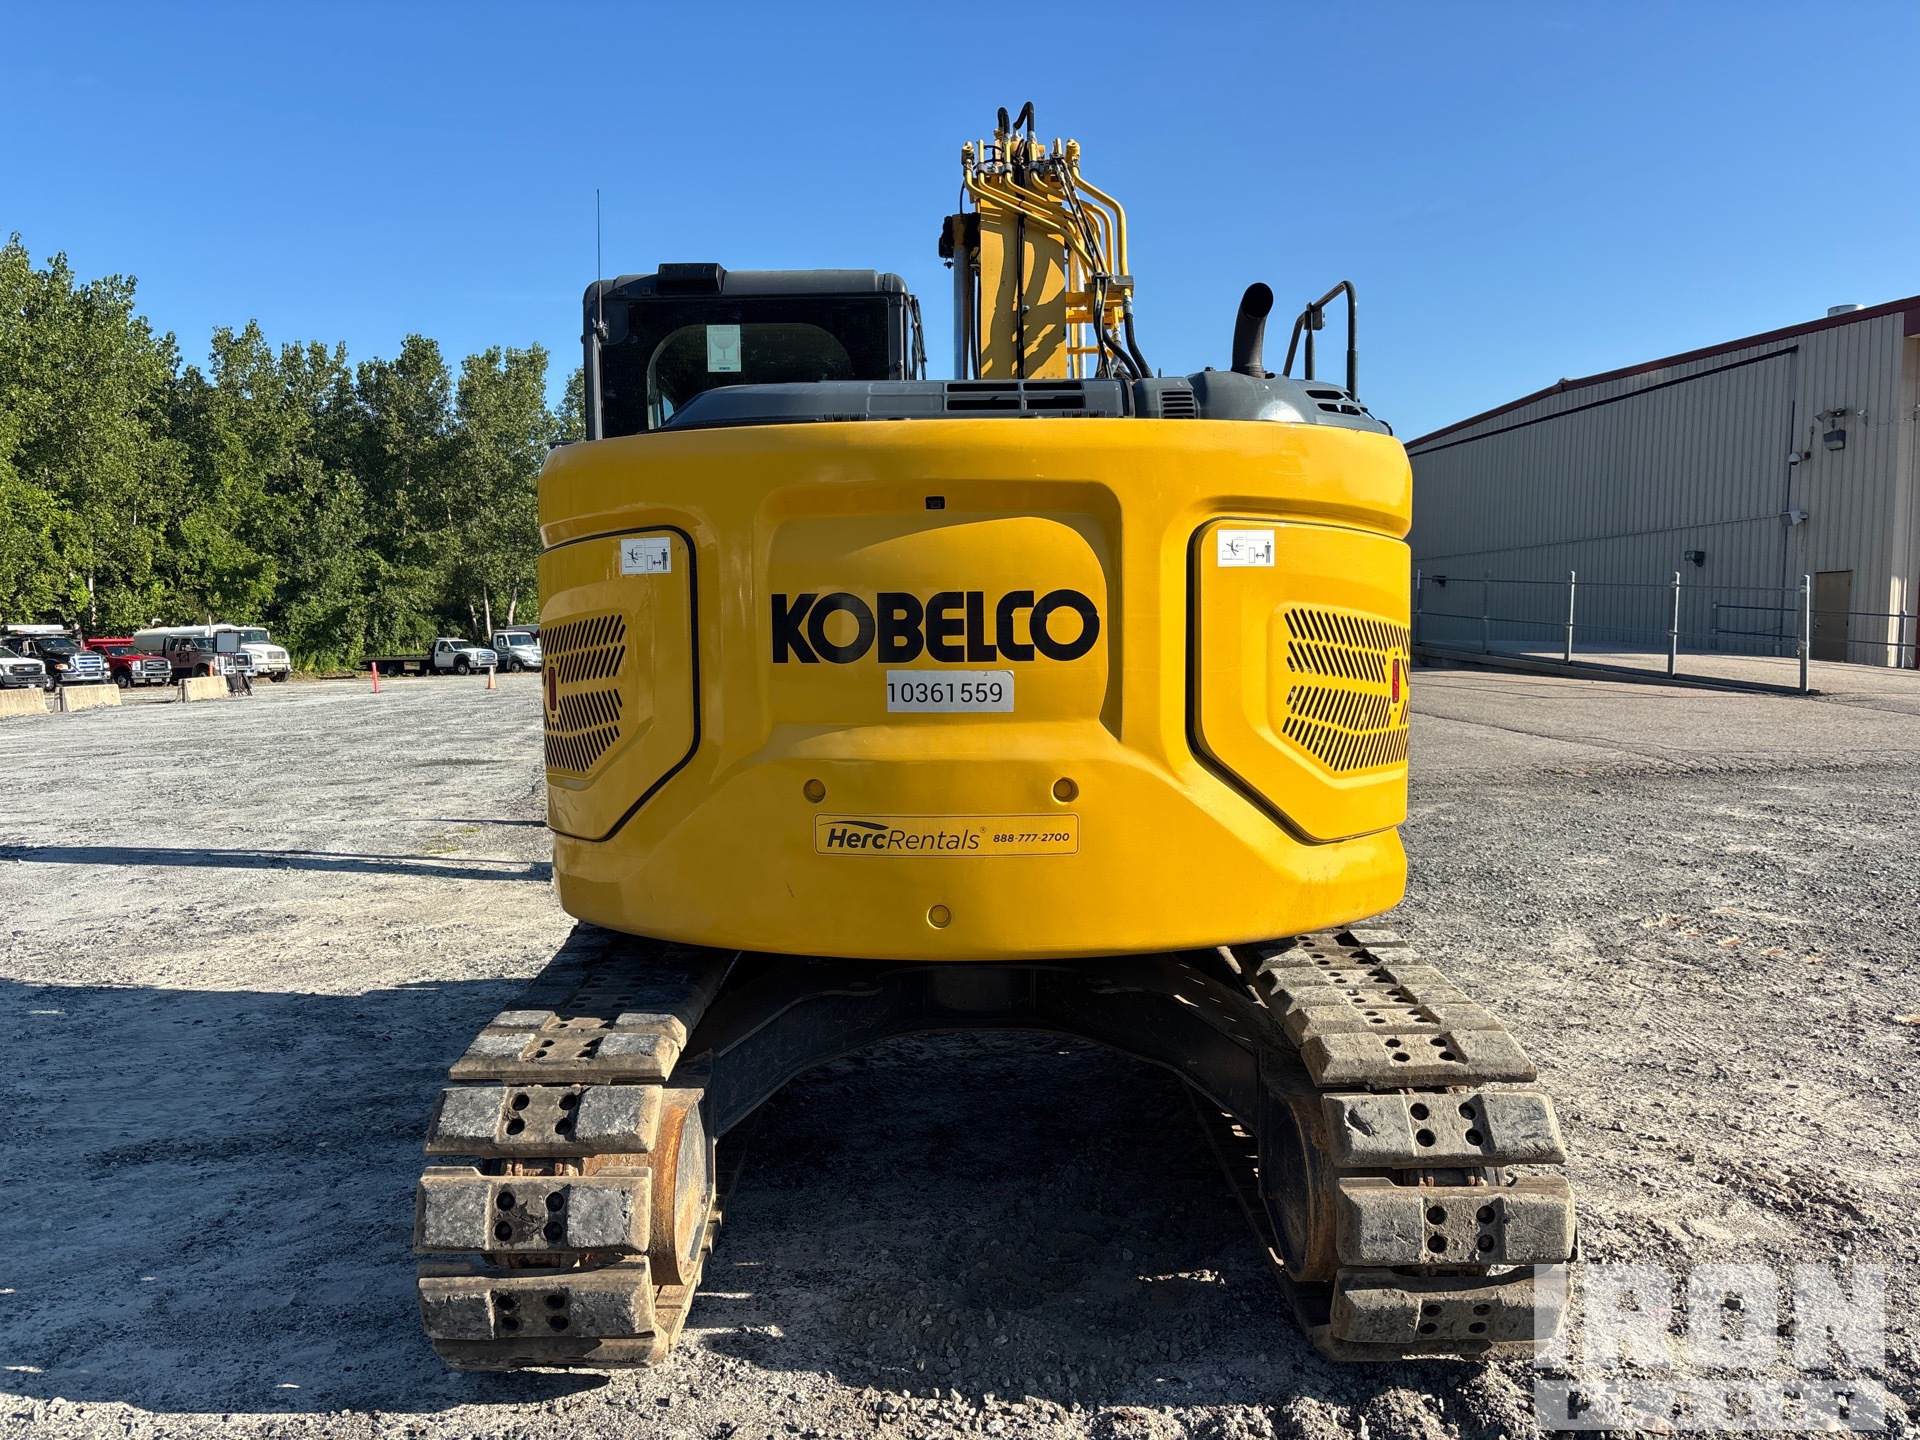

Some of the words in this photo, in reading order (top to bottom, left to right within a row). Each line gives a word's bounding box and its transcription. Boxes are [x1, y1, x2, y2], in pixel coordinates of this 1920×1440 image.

[771, 589, 1099, 663] KOBELCO
[887, 682, 1003, 703] 10361559
[993, 832, 1070, 843] 888-777-2700
